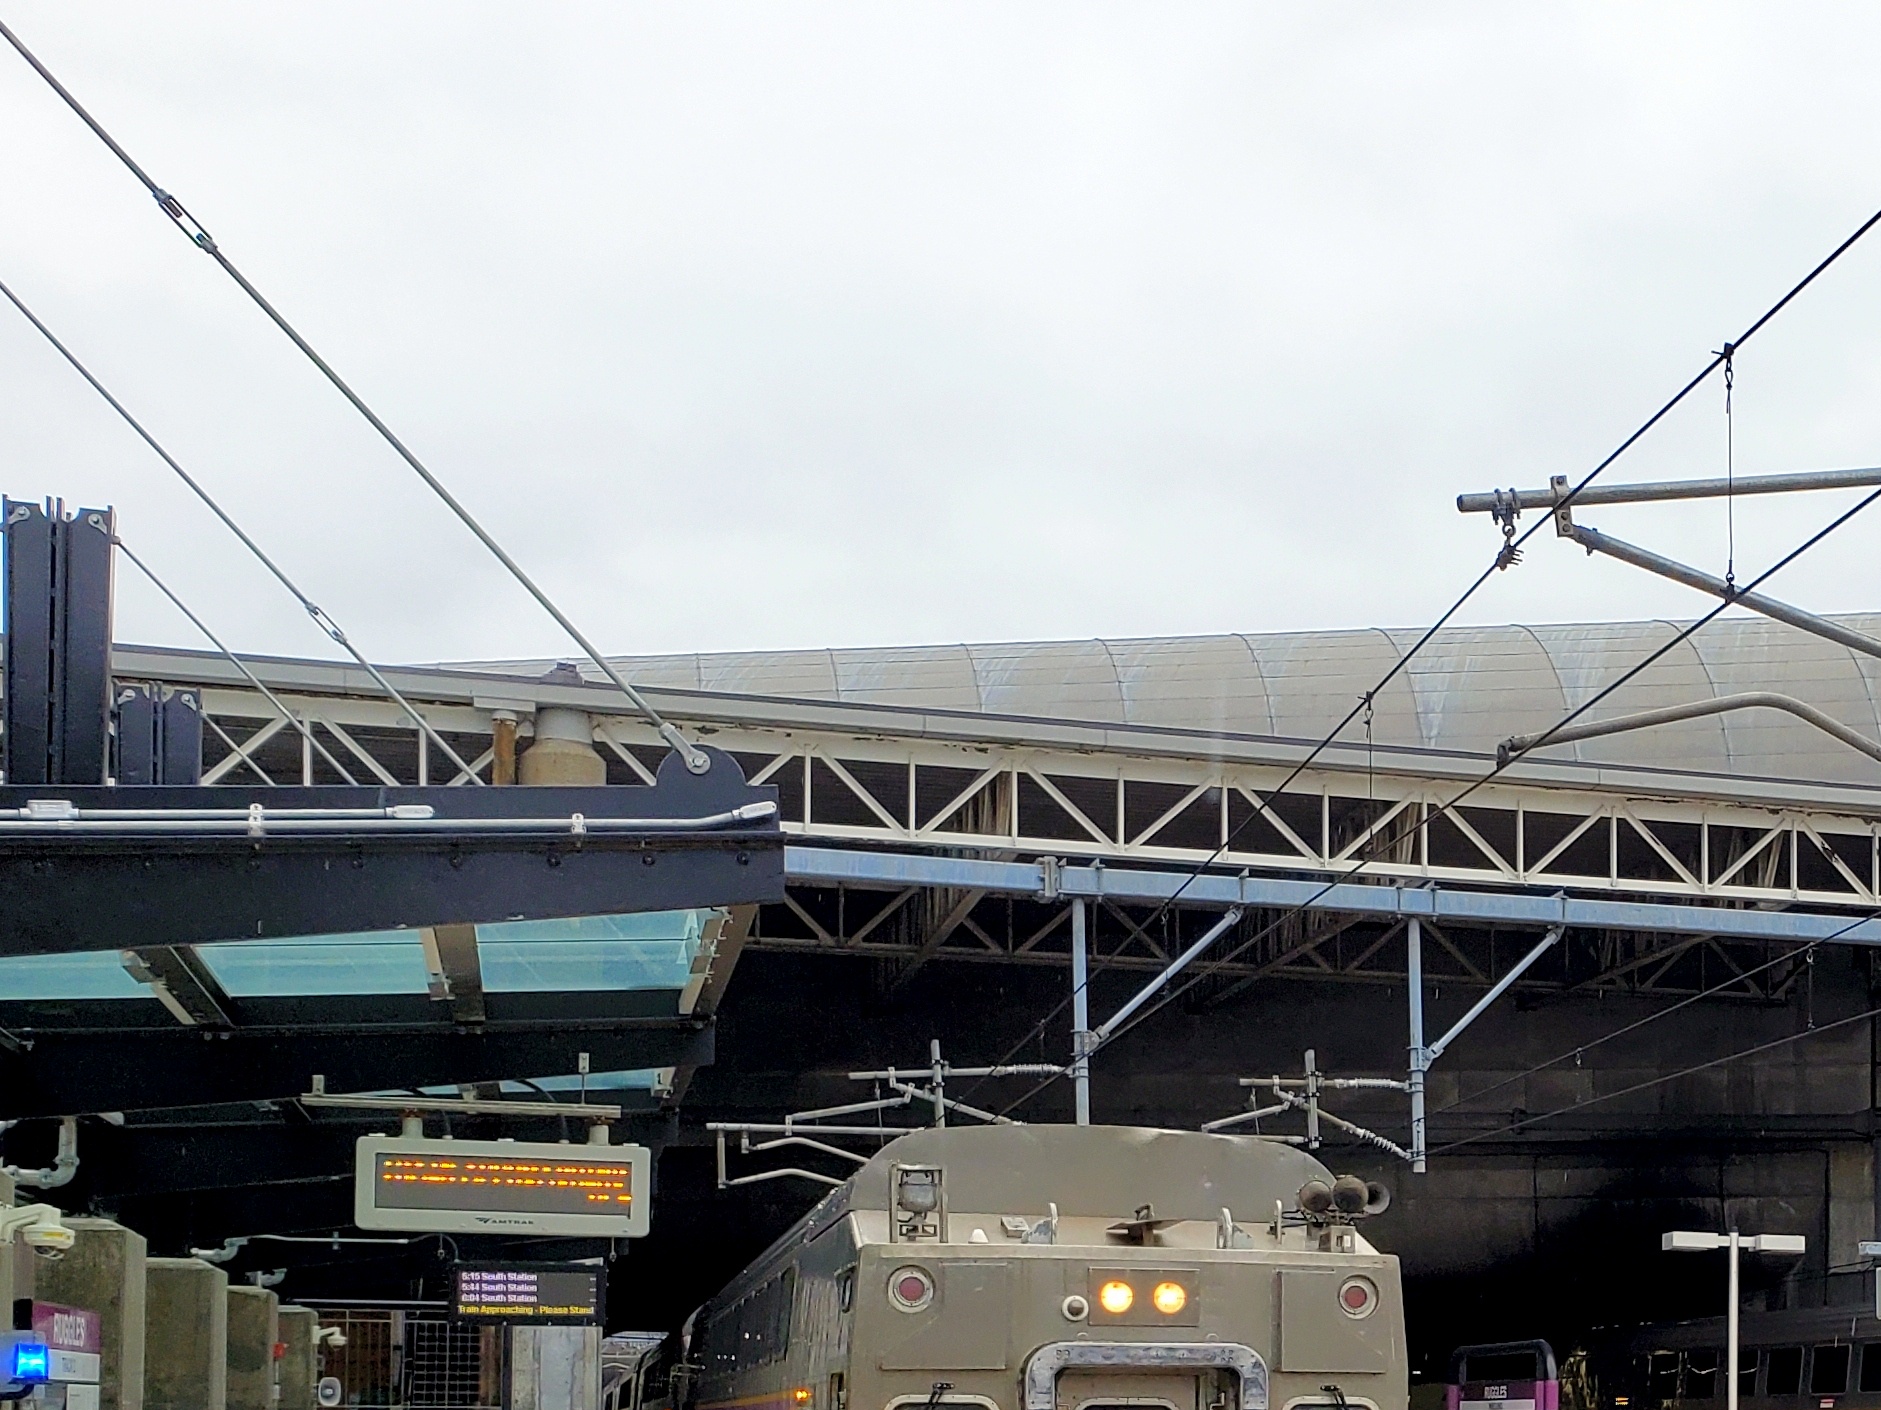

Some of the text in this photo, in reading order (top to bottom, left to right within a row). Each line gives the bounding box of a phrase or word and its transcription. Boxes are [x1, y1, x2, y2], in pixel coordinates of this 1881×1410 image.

[482, 1272, 506, 1281] South
[508, 1272, 538, 1281] Station
[482, 1283, 506, 1292] South
[508, 1283, 538, 1292] Station
[482, 1293, 506, 1303] South
[508, 1293, 538, 1303] Station
[458, 1305, 479, 1314] Train
[480, 1305, 534, 1315] Approaching
[539, 1305, 568, 1314] Please
[569, 1305, 595, 1314] Stand
[53, 1312, 85, 1347] RUGGLES
